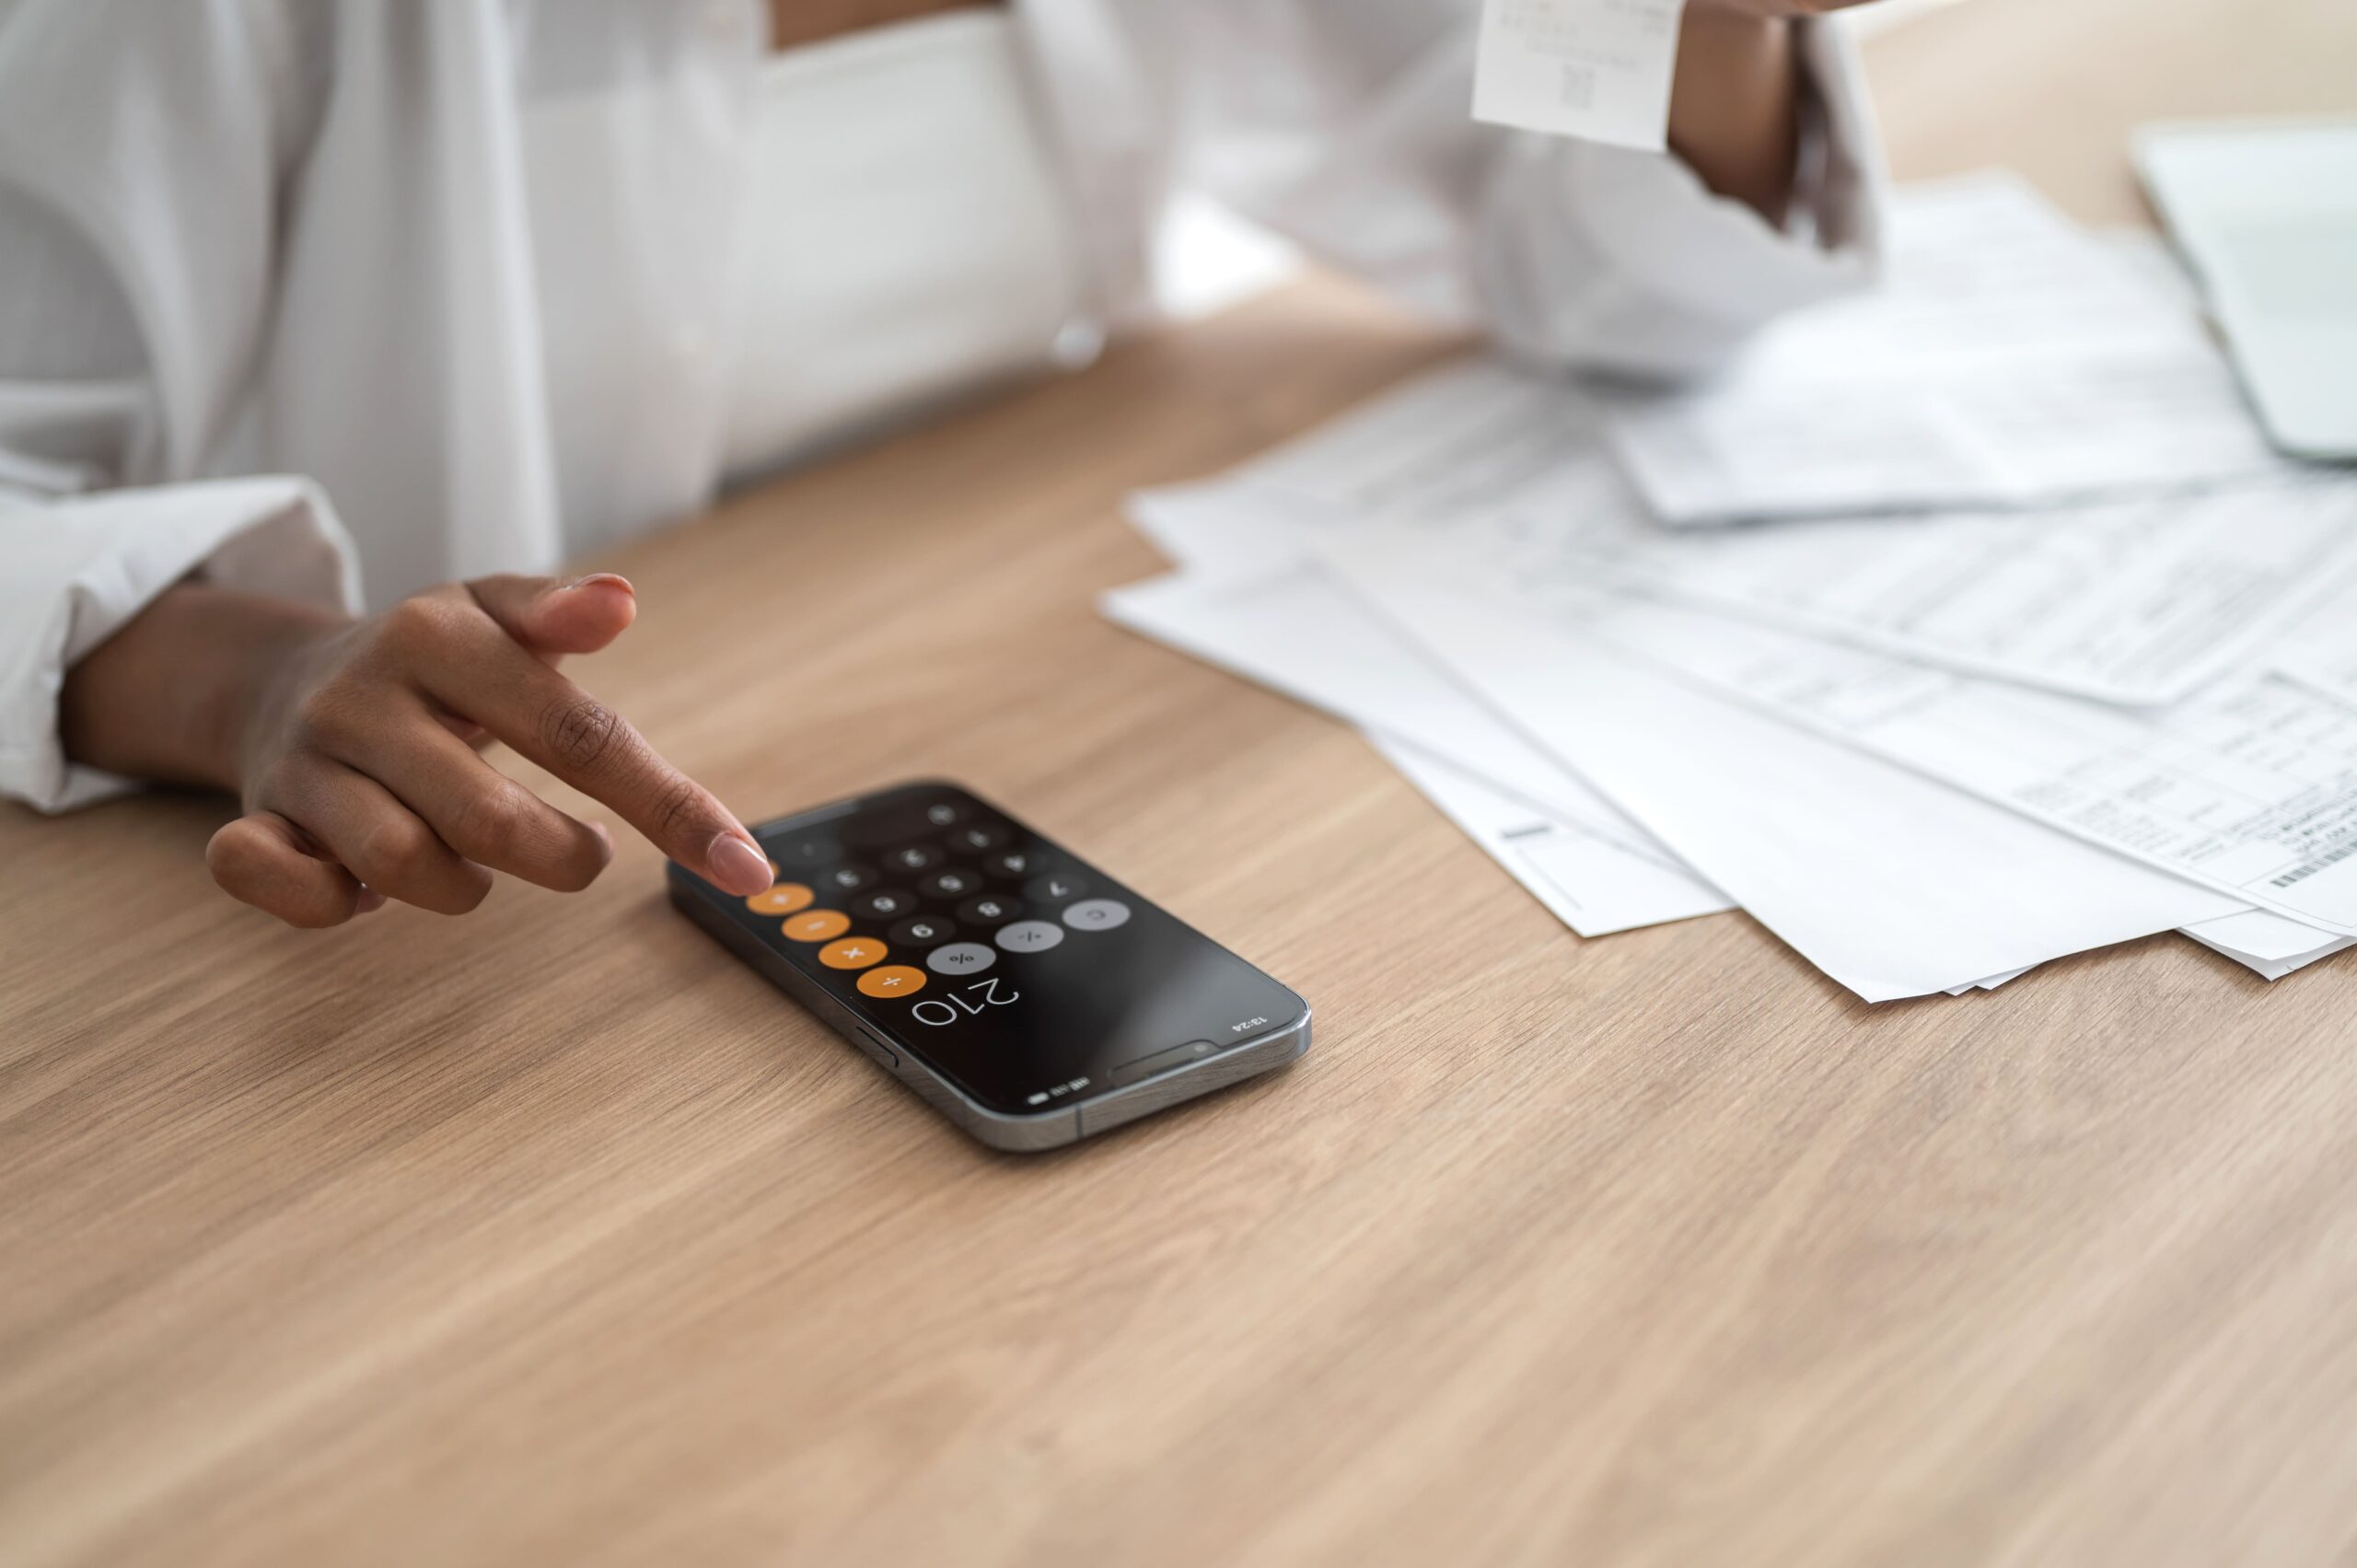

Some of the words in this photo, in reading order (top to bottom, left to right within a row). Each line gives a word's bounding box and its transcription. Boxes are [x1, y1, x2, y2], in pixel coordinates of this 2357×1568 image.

[1050, 881, 1069, 897] 7
[978, 901, 1002, 917] 8
[911, 924, 934, 938] 9
[911, 978, 1019, 1026] 210
[1232, 1016, 1268, 1032] 13:24
